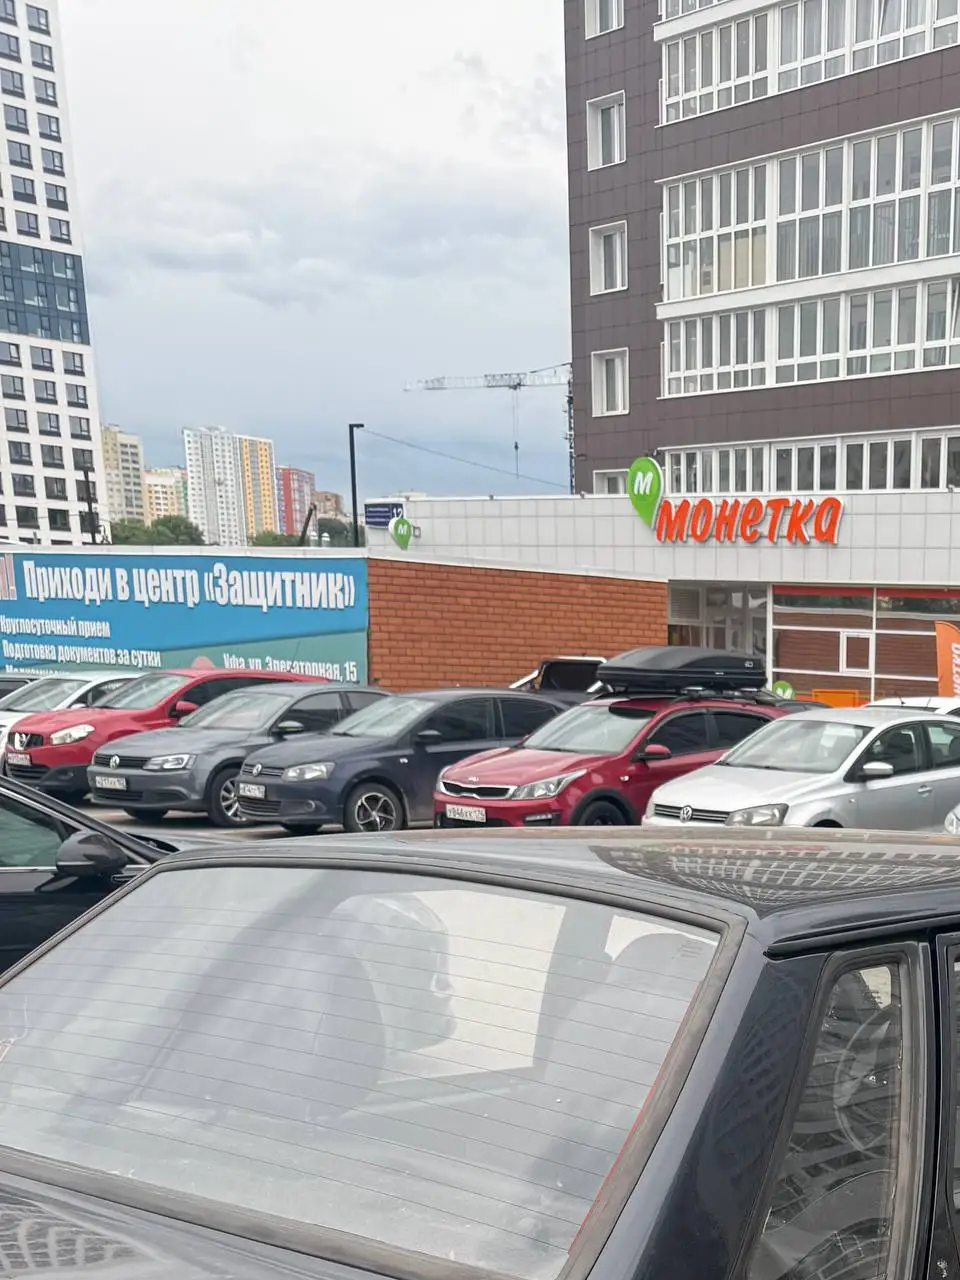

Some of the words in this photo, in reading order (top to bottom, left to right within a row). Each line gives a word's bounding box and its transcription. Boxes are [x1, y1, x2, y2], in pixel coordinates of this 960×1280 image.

[23, 560, 113, 606] Приходи
[115, 567, 129, 601] в
[132, 567, 199, 608] центр
[203, 562, 356, 613] «Защитник»
[0, 615, 77, 637] Круглосуточный
[79, 620, 111, 638] прием
[2, 639, 57, 661] Подготовка
[57, 644, 116, 663] документов
[117, 651, 130, 663] за
[131, 651, 162, 668] сутки
[344, 661, 358, 682] 15
